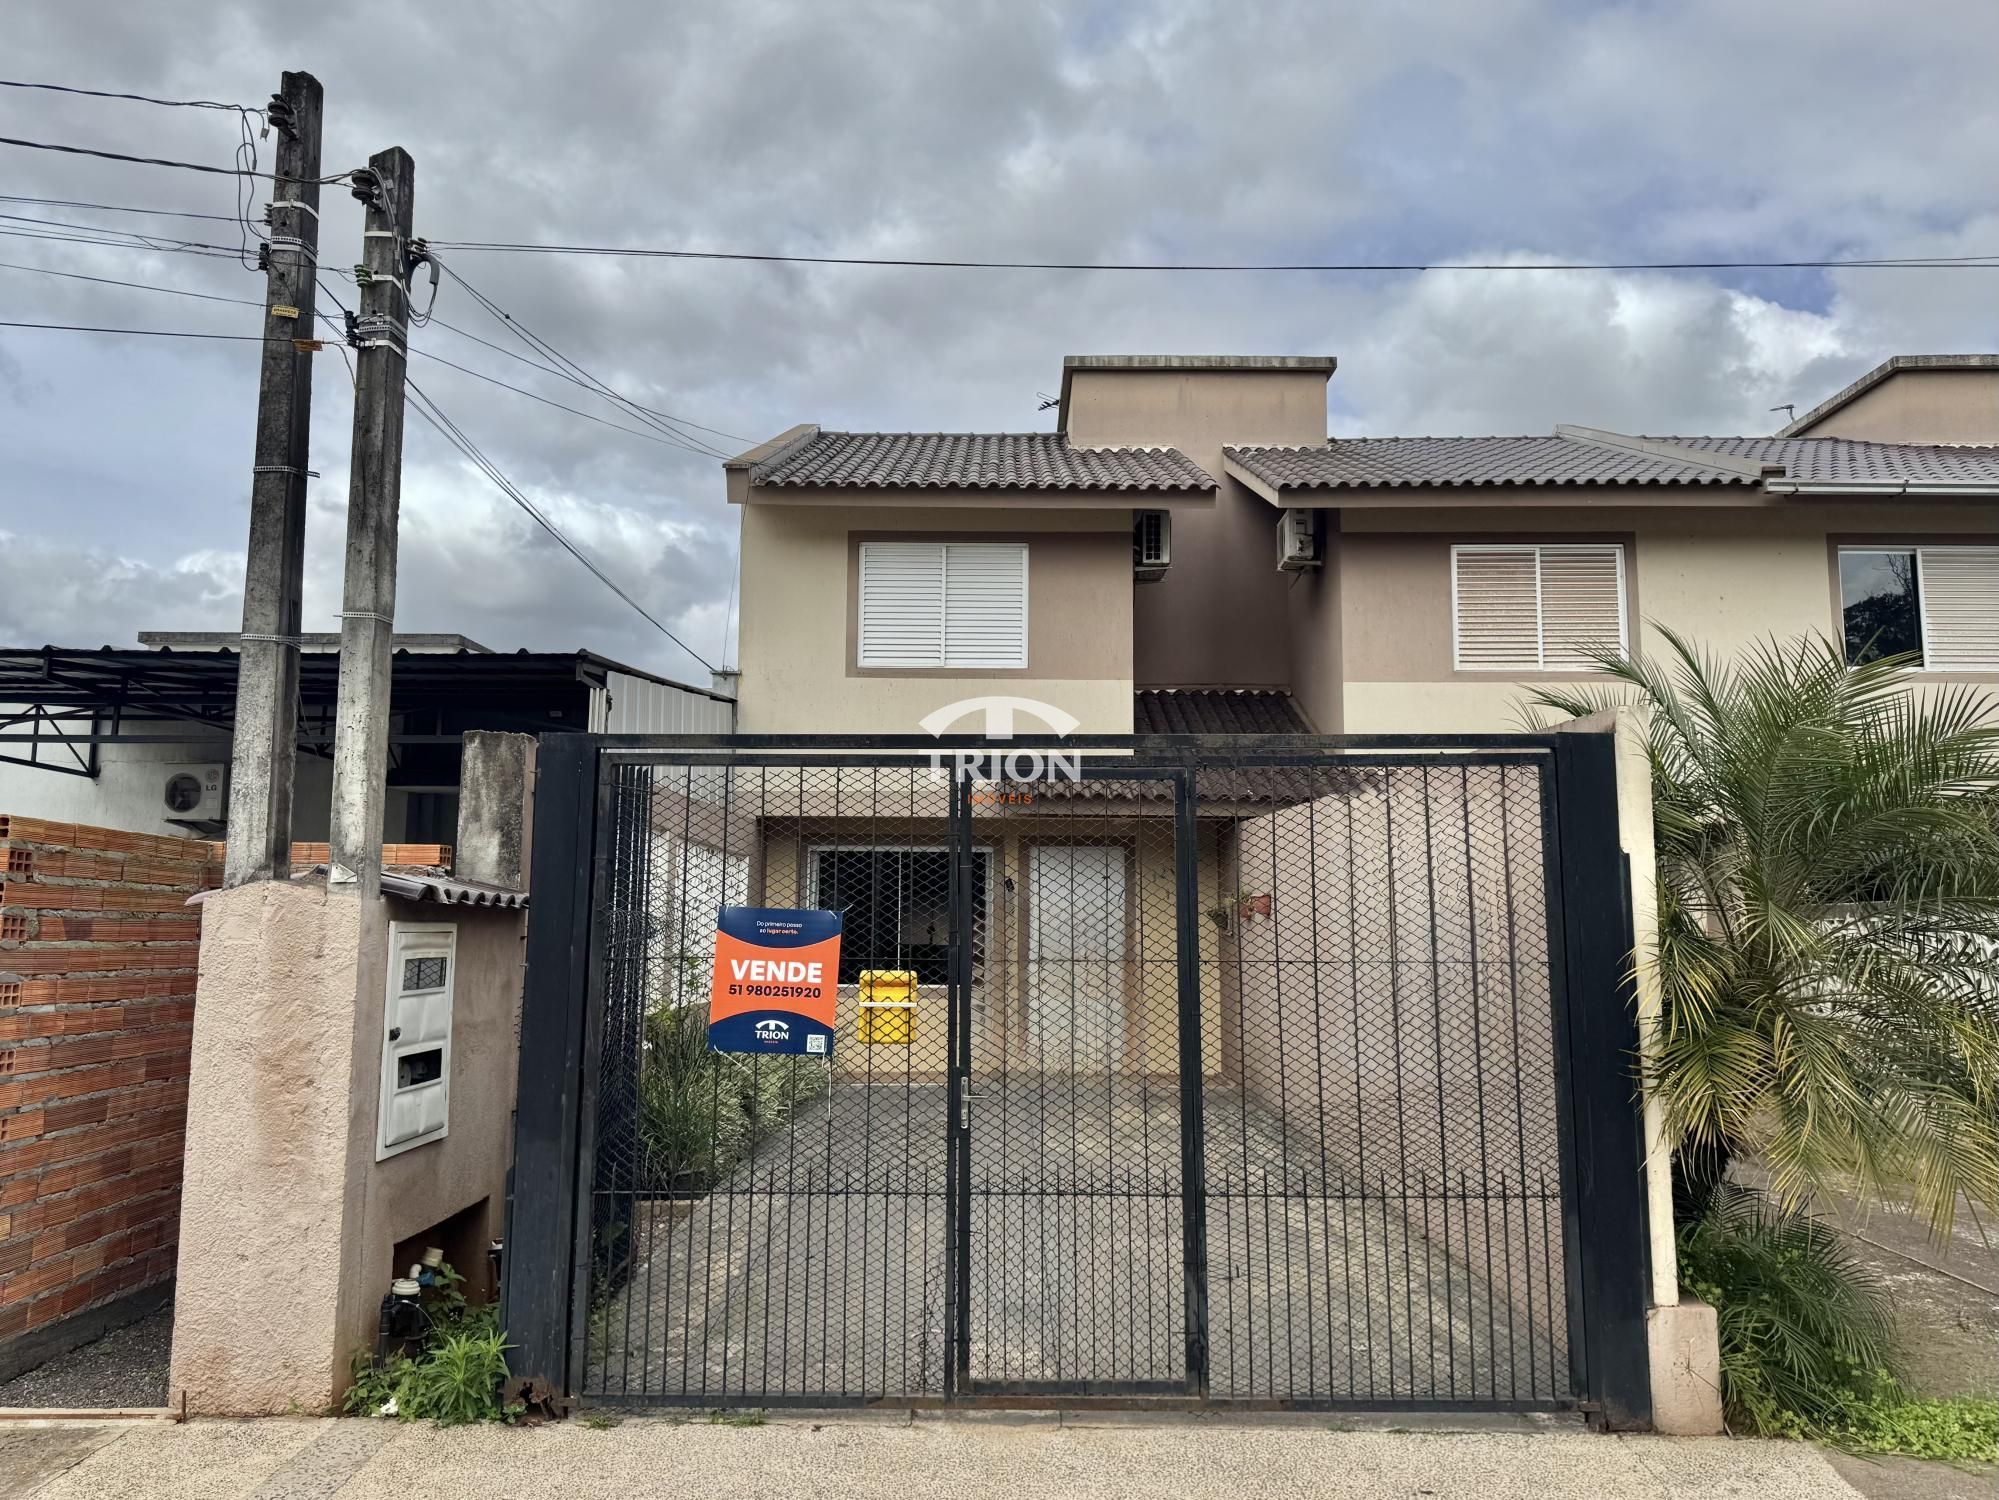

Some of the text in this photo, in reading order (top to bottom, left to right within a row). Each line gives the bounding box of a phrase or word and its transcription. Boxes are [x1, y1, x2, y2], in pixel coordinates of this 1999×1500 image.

[730, 959, 822, 984] VENDE
[728, 984, 821, 998] 51 980251920
[754, 1030, 789, 1040] TRION
